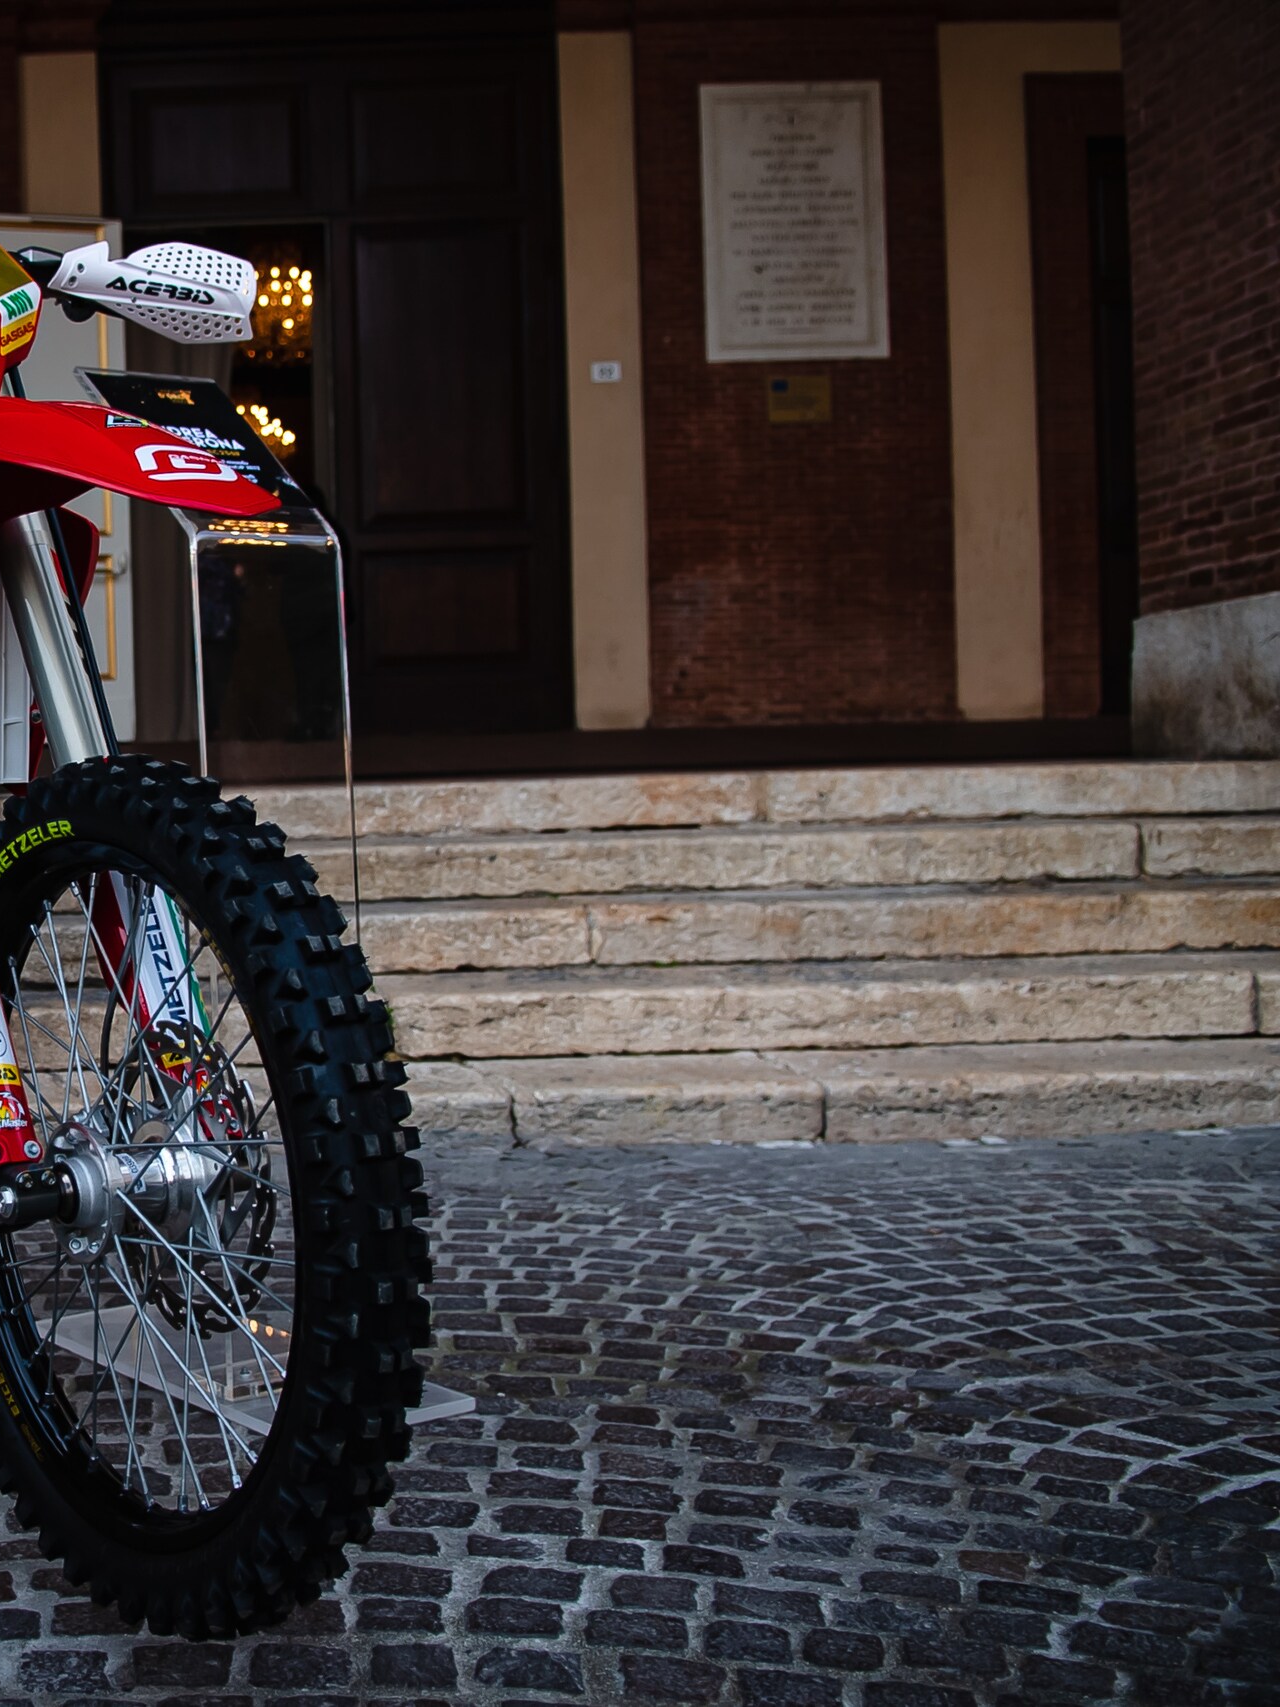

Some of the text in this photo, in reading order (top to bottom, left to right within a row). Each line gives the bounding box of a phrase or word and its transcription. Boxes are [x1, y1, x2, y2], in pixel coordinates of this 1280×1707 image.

[1, 289, 34, 320] AMV
[105, 276, 215, 305] ACERBIS
[0, 321, 34, 348] GASGAS
[140, 896, 188, 1027] METZELE
